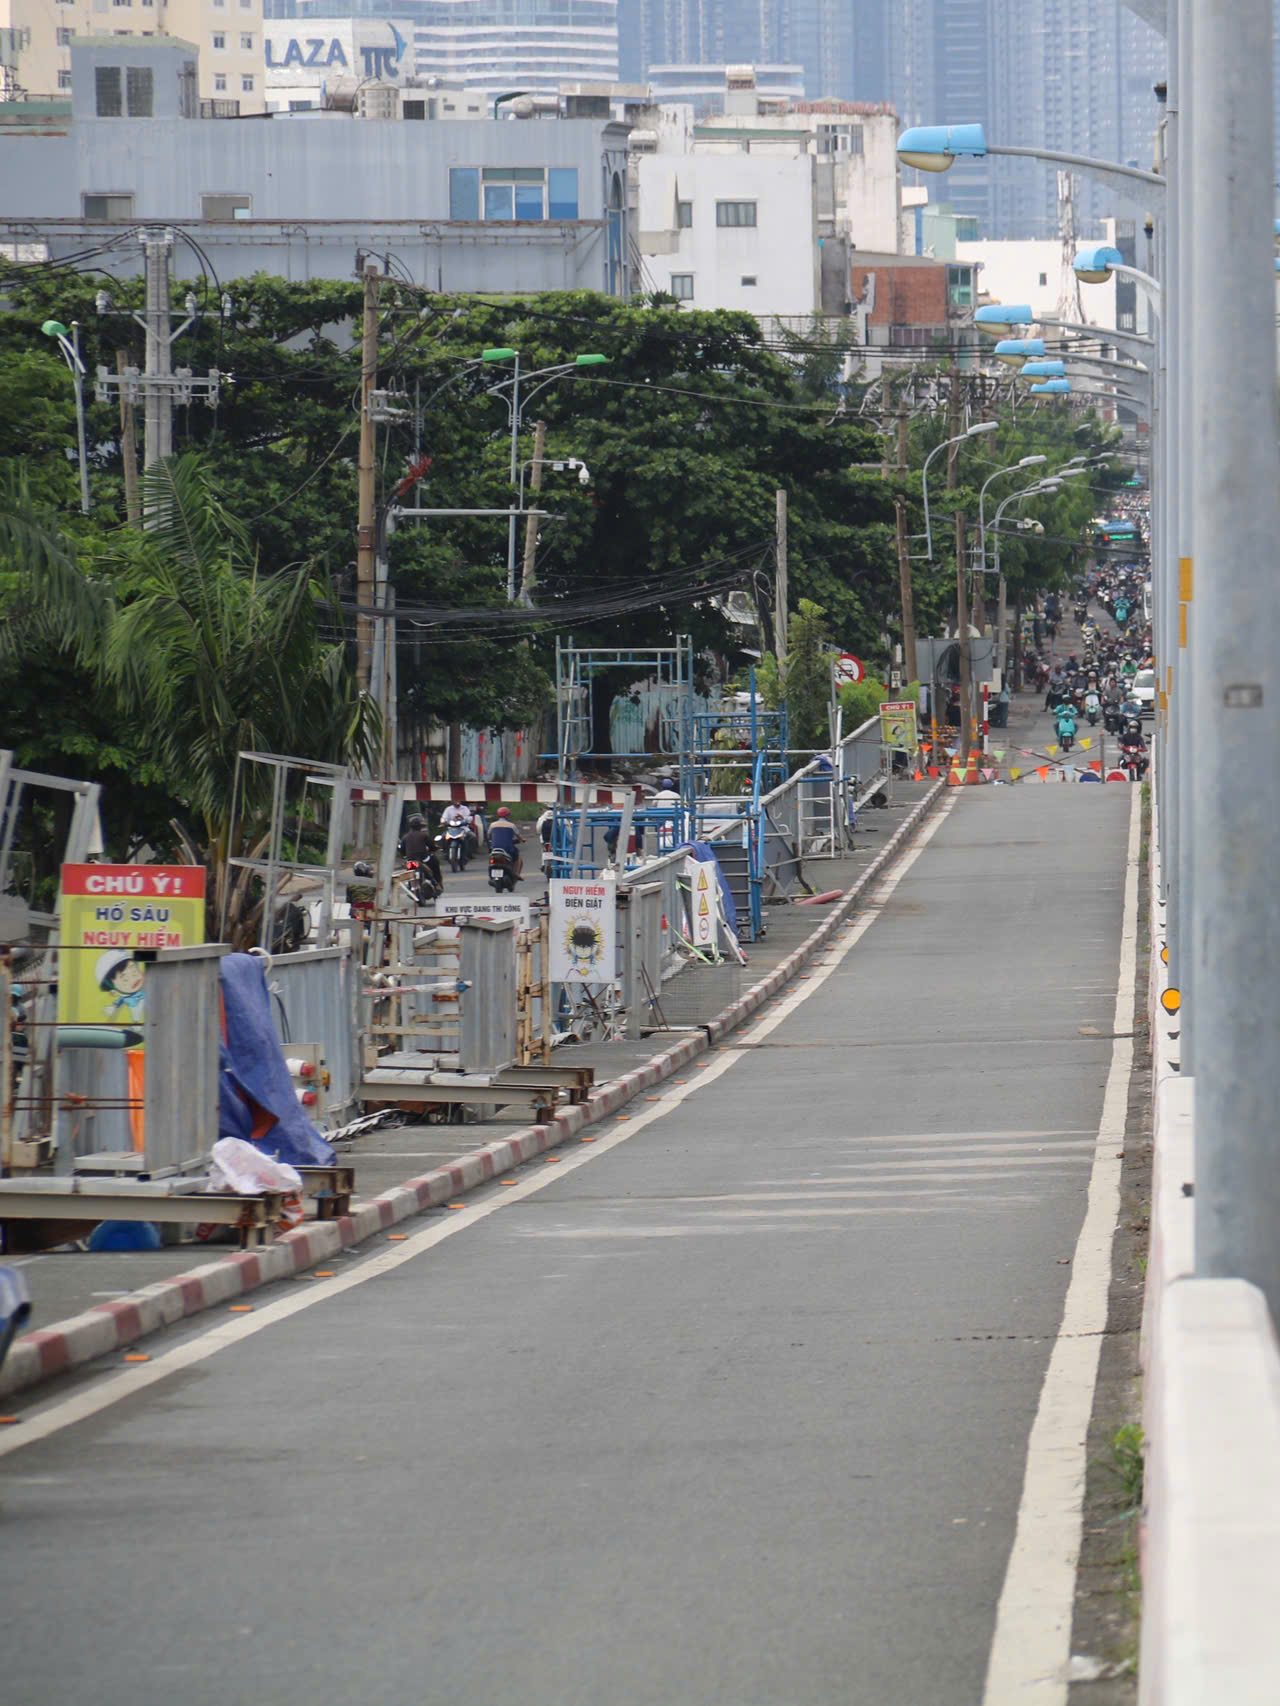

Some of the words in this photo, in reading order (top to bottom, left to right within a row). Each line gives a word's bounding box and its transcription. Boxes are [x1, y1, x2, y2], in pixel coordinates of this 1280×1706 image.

[265, 38, 348, 67] LAZA
[85, 872, 144, 893] CHÚ
[151, 873, 183, 894] Ý!
[563, 885, 584, 895] NGUY
[96, 902, 126, 921] HỐ
[130, 905, 169, 922] SÂU
[83, 931, 131, 946] NGUY
[137, 926, 181, 947] HIỂM
